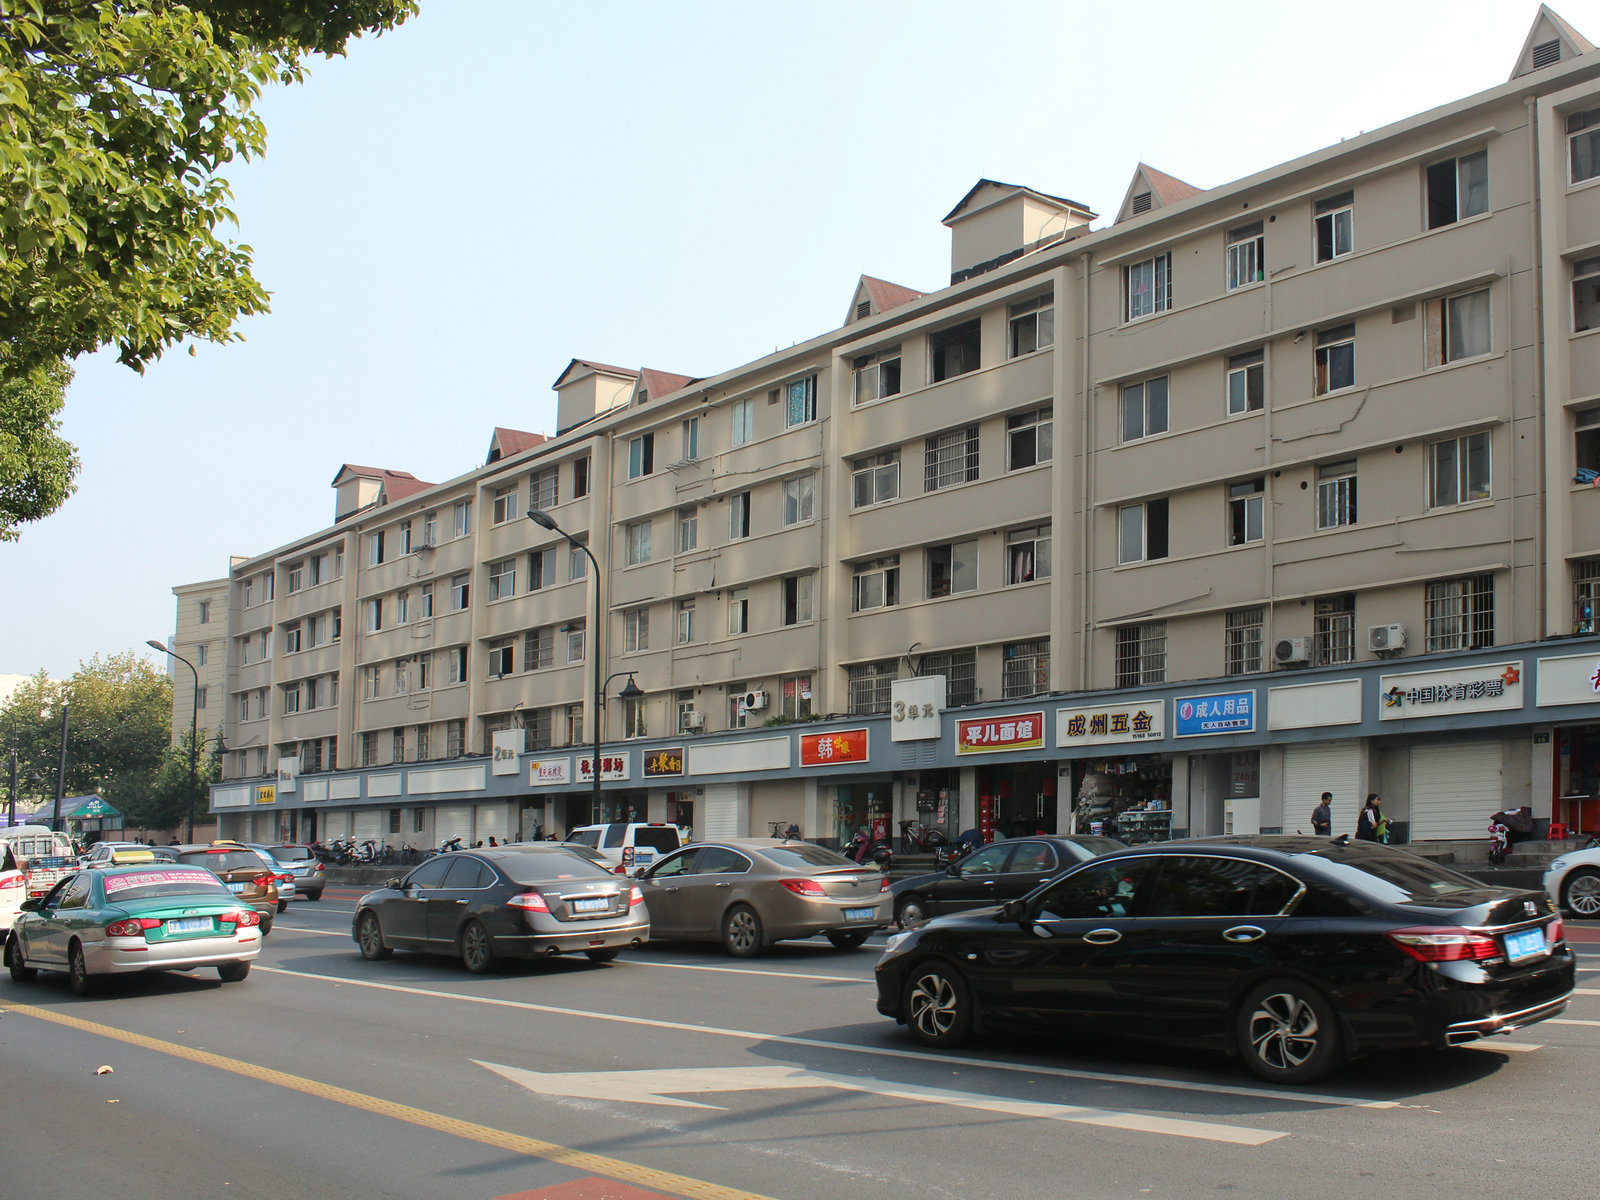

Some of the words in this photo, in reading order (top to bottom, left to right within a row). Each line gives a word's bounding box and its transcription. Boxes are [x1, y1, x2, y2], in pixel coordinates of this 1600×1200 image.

[1405, 678, 1504, 704] 中国体育彩票
[893, 700, 935, 723] 3单元
[1195, 697, 1249, 718] 成人用品
[966, 720, 1034, 744] 平儿面馆
[1066, 710, 1153, 736] 成州五金
